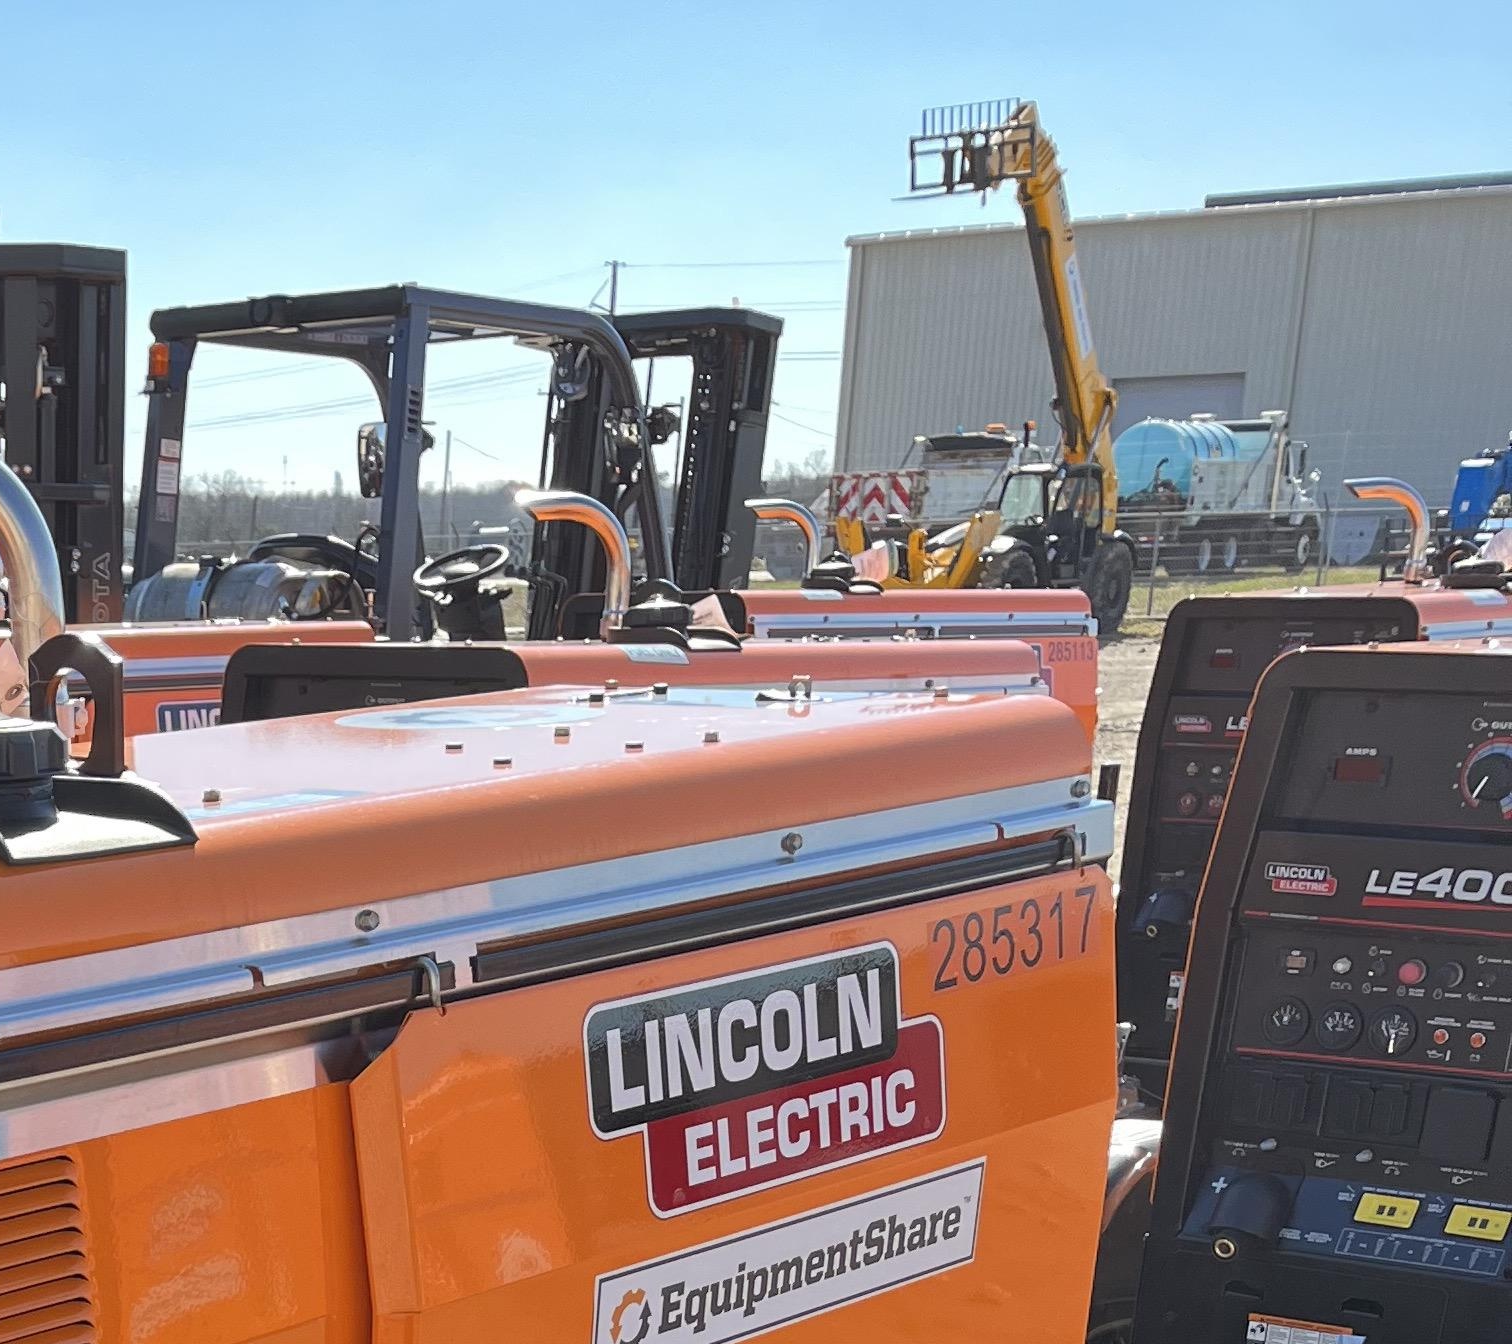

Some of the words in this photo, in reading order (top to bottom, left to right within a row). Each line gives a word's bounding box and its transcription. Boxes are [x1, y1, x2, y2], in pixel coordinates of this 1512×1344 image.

[1048, 641, 1094, 662] 285113
[1268, 865, 1326, 882] LINCOLN
[1279, 880, 1330, 893] ELECTRIC
[932, 884, 1096, 992] 285317
[606, 969, 884, 1114] LINCOLN
[684, 1068, 916, 1189] ELECTRIC
[657, 1203, 962, 1336] EquipmentShare
